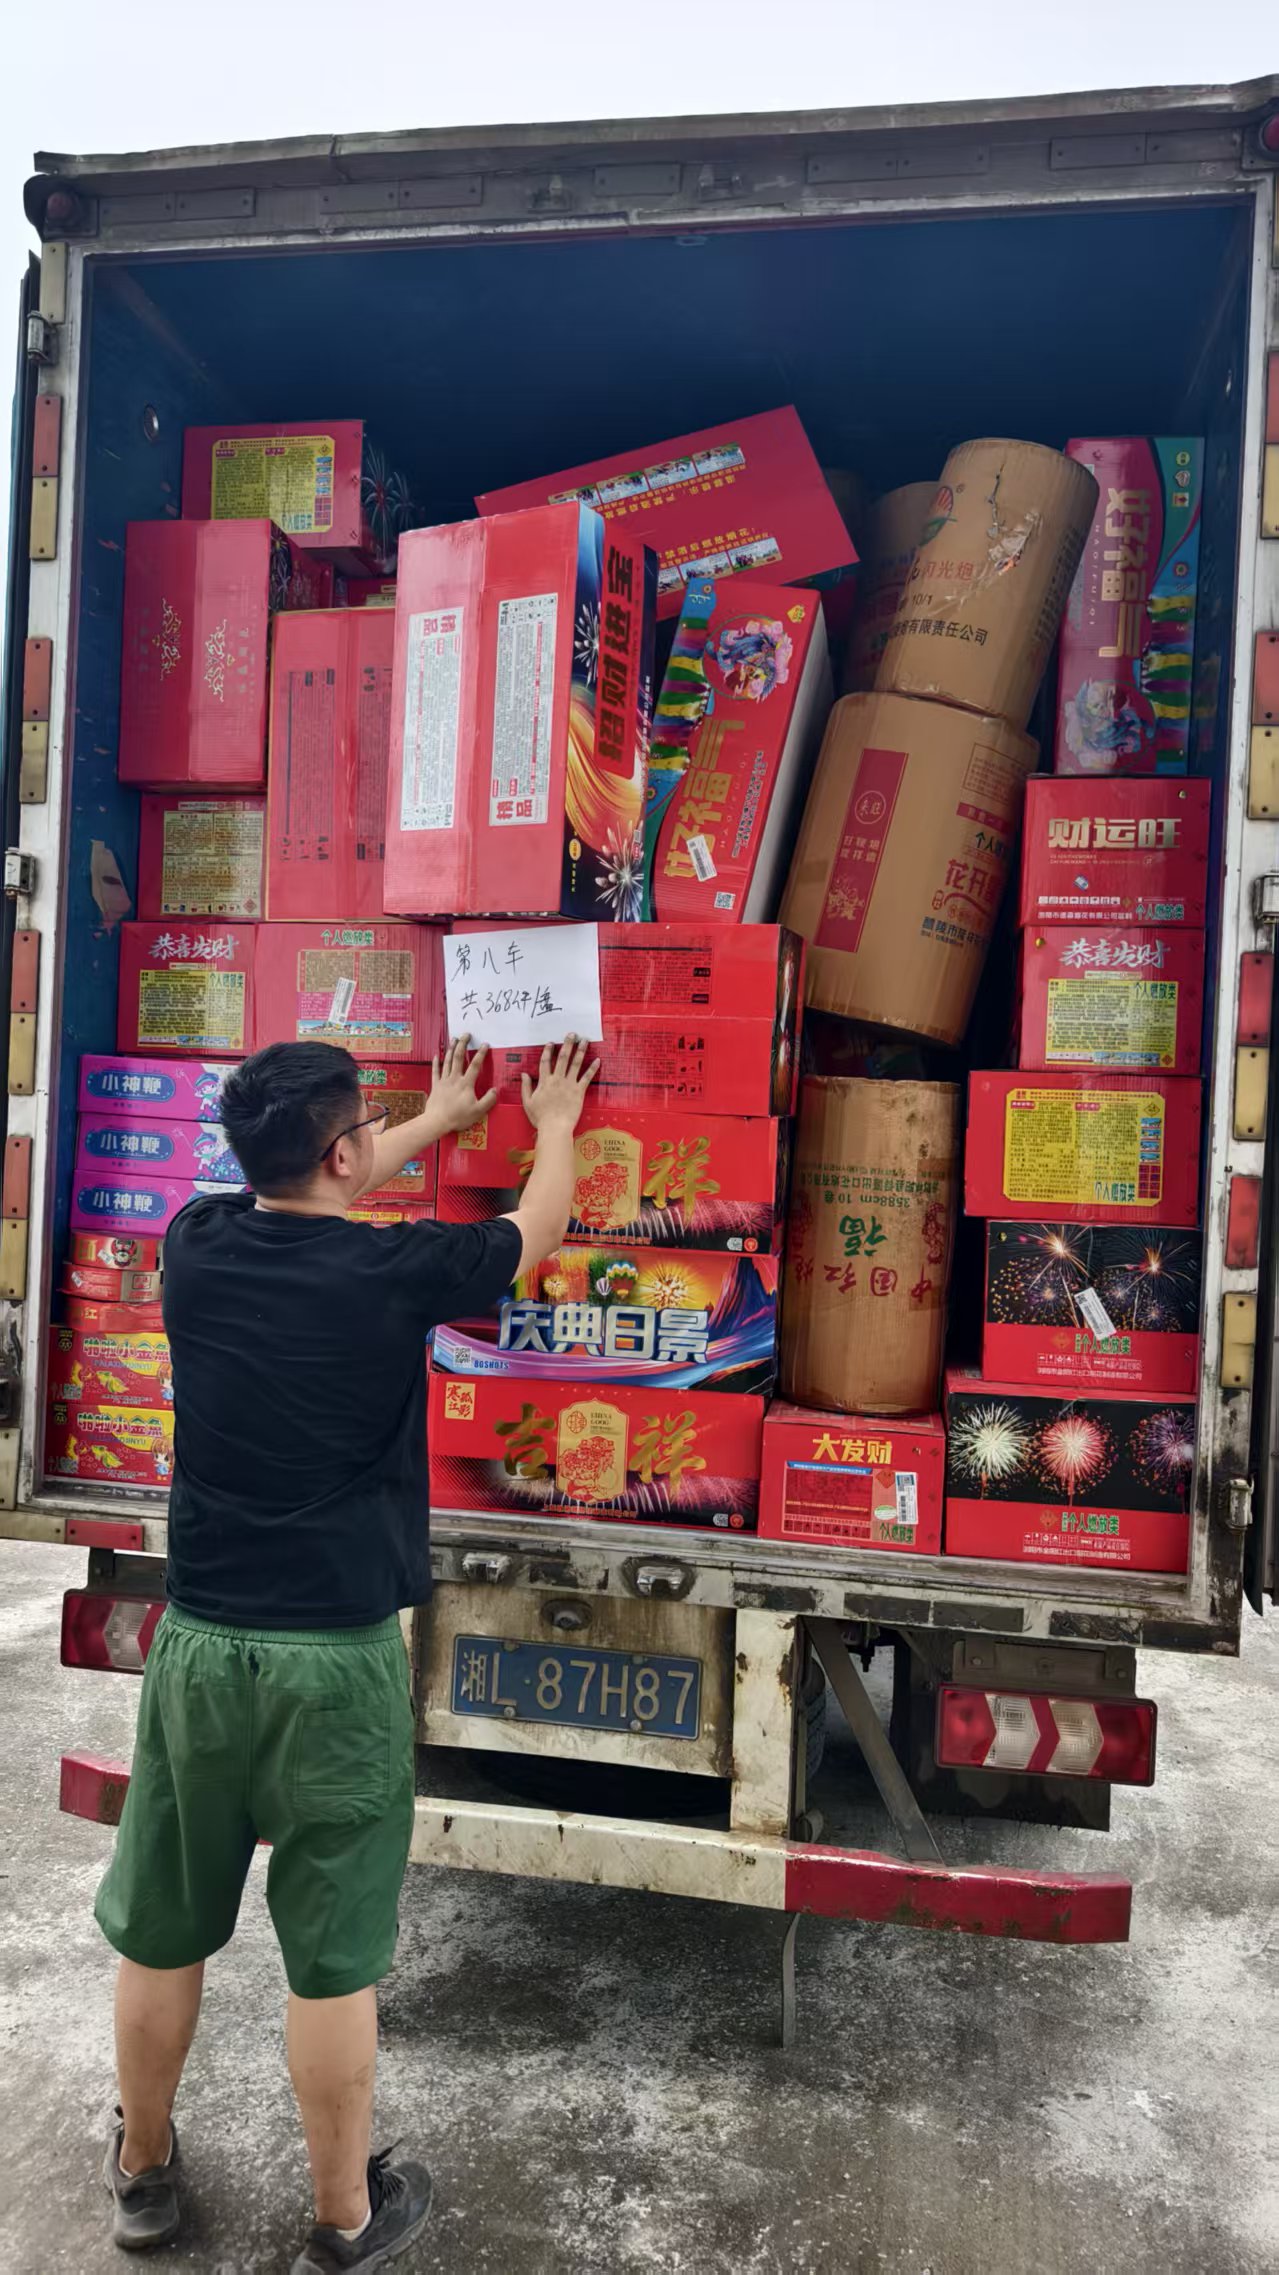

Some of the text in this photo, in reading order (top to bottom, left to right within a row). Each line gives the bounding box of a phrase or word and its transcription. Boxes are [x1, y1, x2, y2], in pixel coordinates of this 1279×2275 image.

[1098, 488, 1152, 658] 好福气
[598, 545, 634, 763] 招财进宝
[496, 799, 532, 820] 精品
[664, 718, 746, 879] 好福气
[1048, 817, 1182, 849] 财运旺
[1135, 903, 1185, 921] 个人燃放类
[148, 932, 239, 961] 恭喜发财
[321, 929, 376, 947] 个人燃放类
[1059, 937, 1171, 969] 恭喜发财
[101, 1073, 162, 1095] 小神鞭
[100, 1133, 160, 1155] 小神鞭
[644, 1135, 721, 1227] 祥
[92, 1190, 153, 1213] 小神鞭
[838, 1214, 888, 1259] 福
[499, 1301, 709, 1363] 庆典日景
[1081, 1333, 1131, 1355] 个人燃放类
[812, 1432, 893, 1465] 大发财
[1068, 1511, 1120, 1536] 个人燃放类
